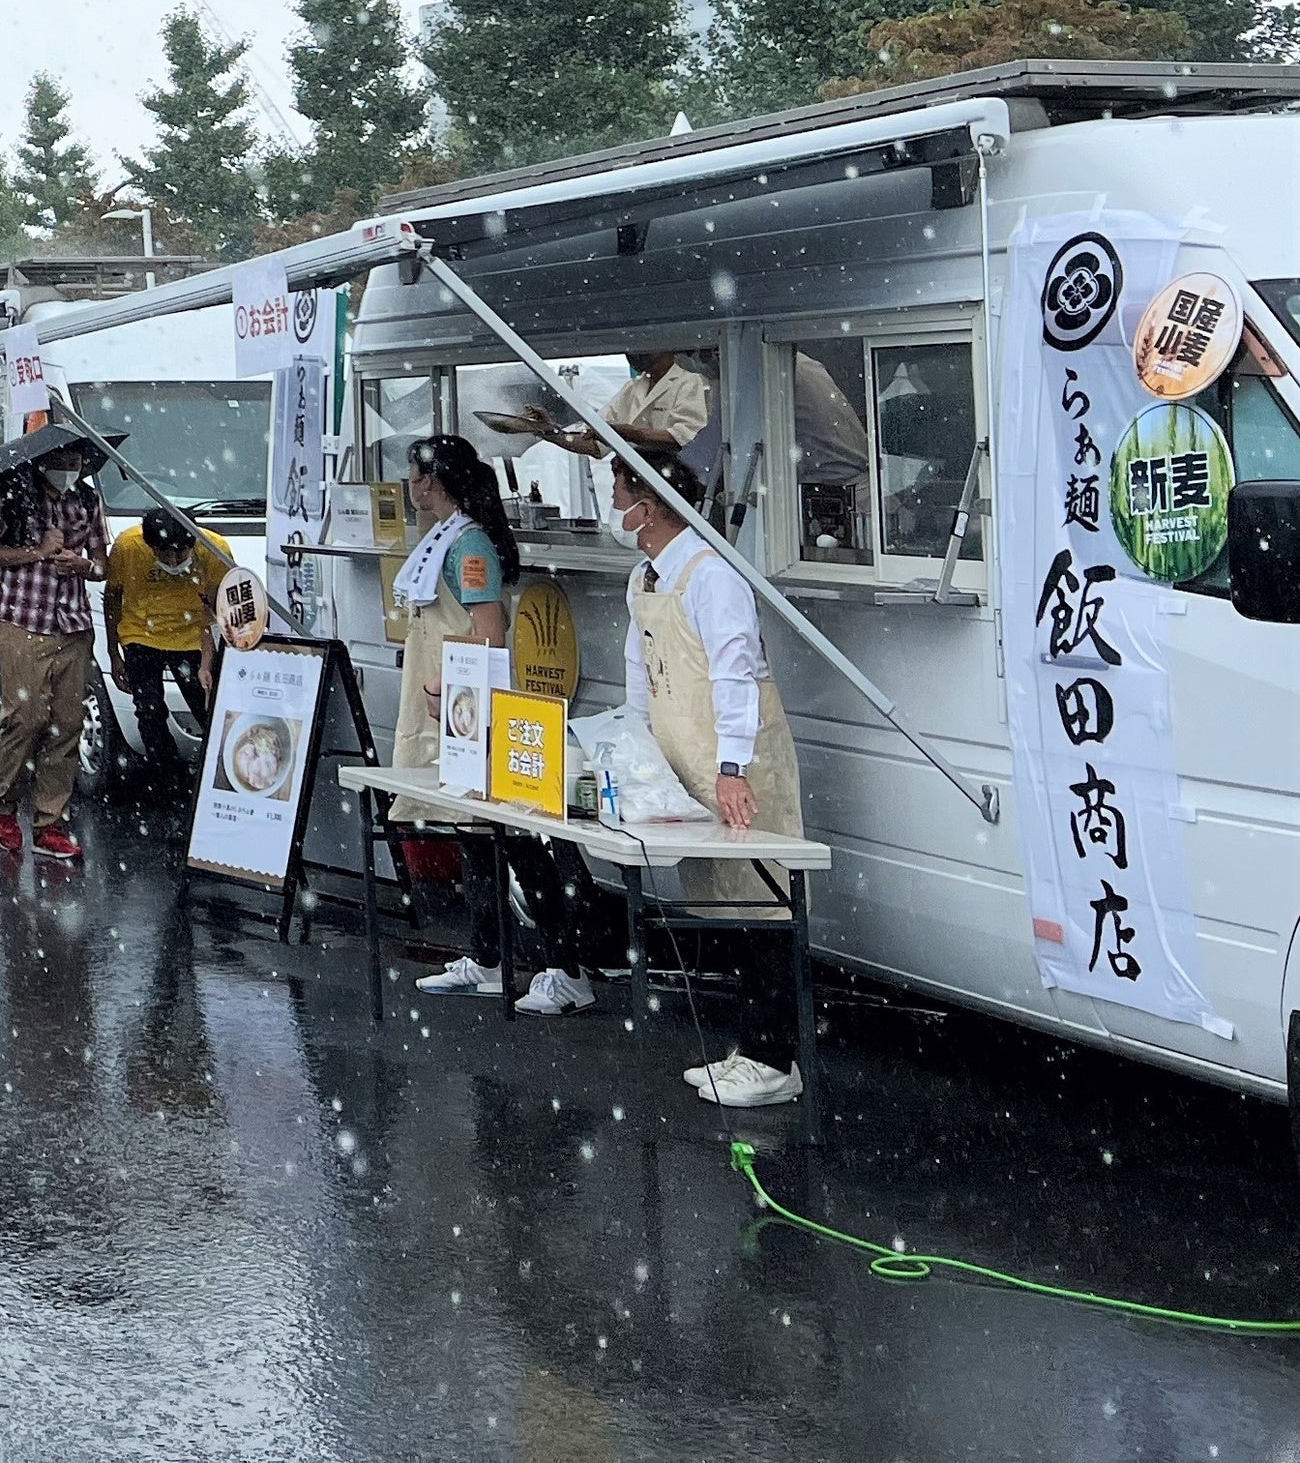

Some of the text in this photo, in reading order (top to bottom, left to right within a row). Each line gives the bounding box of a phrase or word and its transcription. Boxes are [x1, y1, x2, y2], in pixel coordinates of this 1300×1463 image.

[1167, 289, 1225, 334] 国産
[1154, 323, 1211, 367] 小麦
[1128, 451, 1212, 515] 新麦
[1145, 529, 1201, 545] FESTIVAL
[1147, 515, 1199, 531] HARVEST
[226, 580, 253, 605] 国産
[525, 664, 566, 680] HARVEST
[525, 679, 566, 696] FESTIVAL
[507, 718, 545, 749] ご注文
[507, 749, 545, 780] お会計
[1036, 548, 1142, 982] 飯田商店
